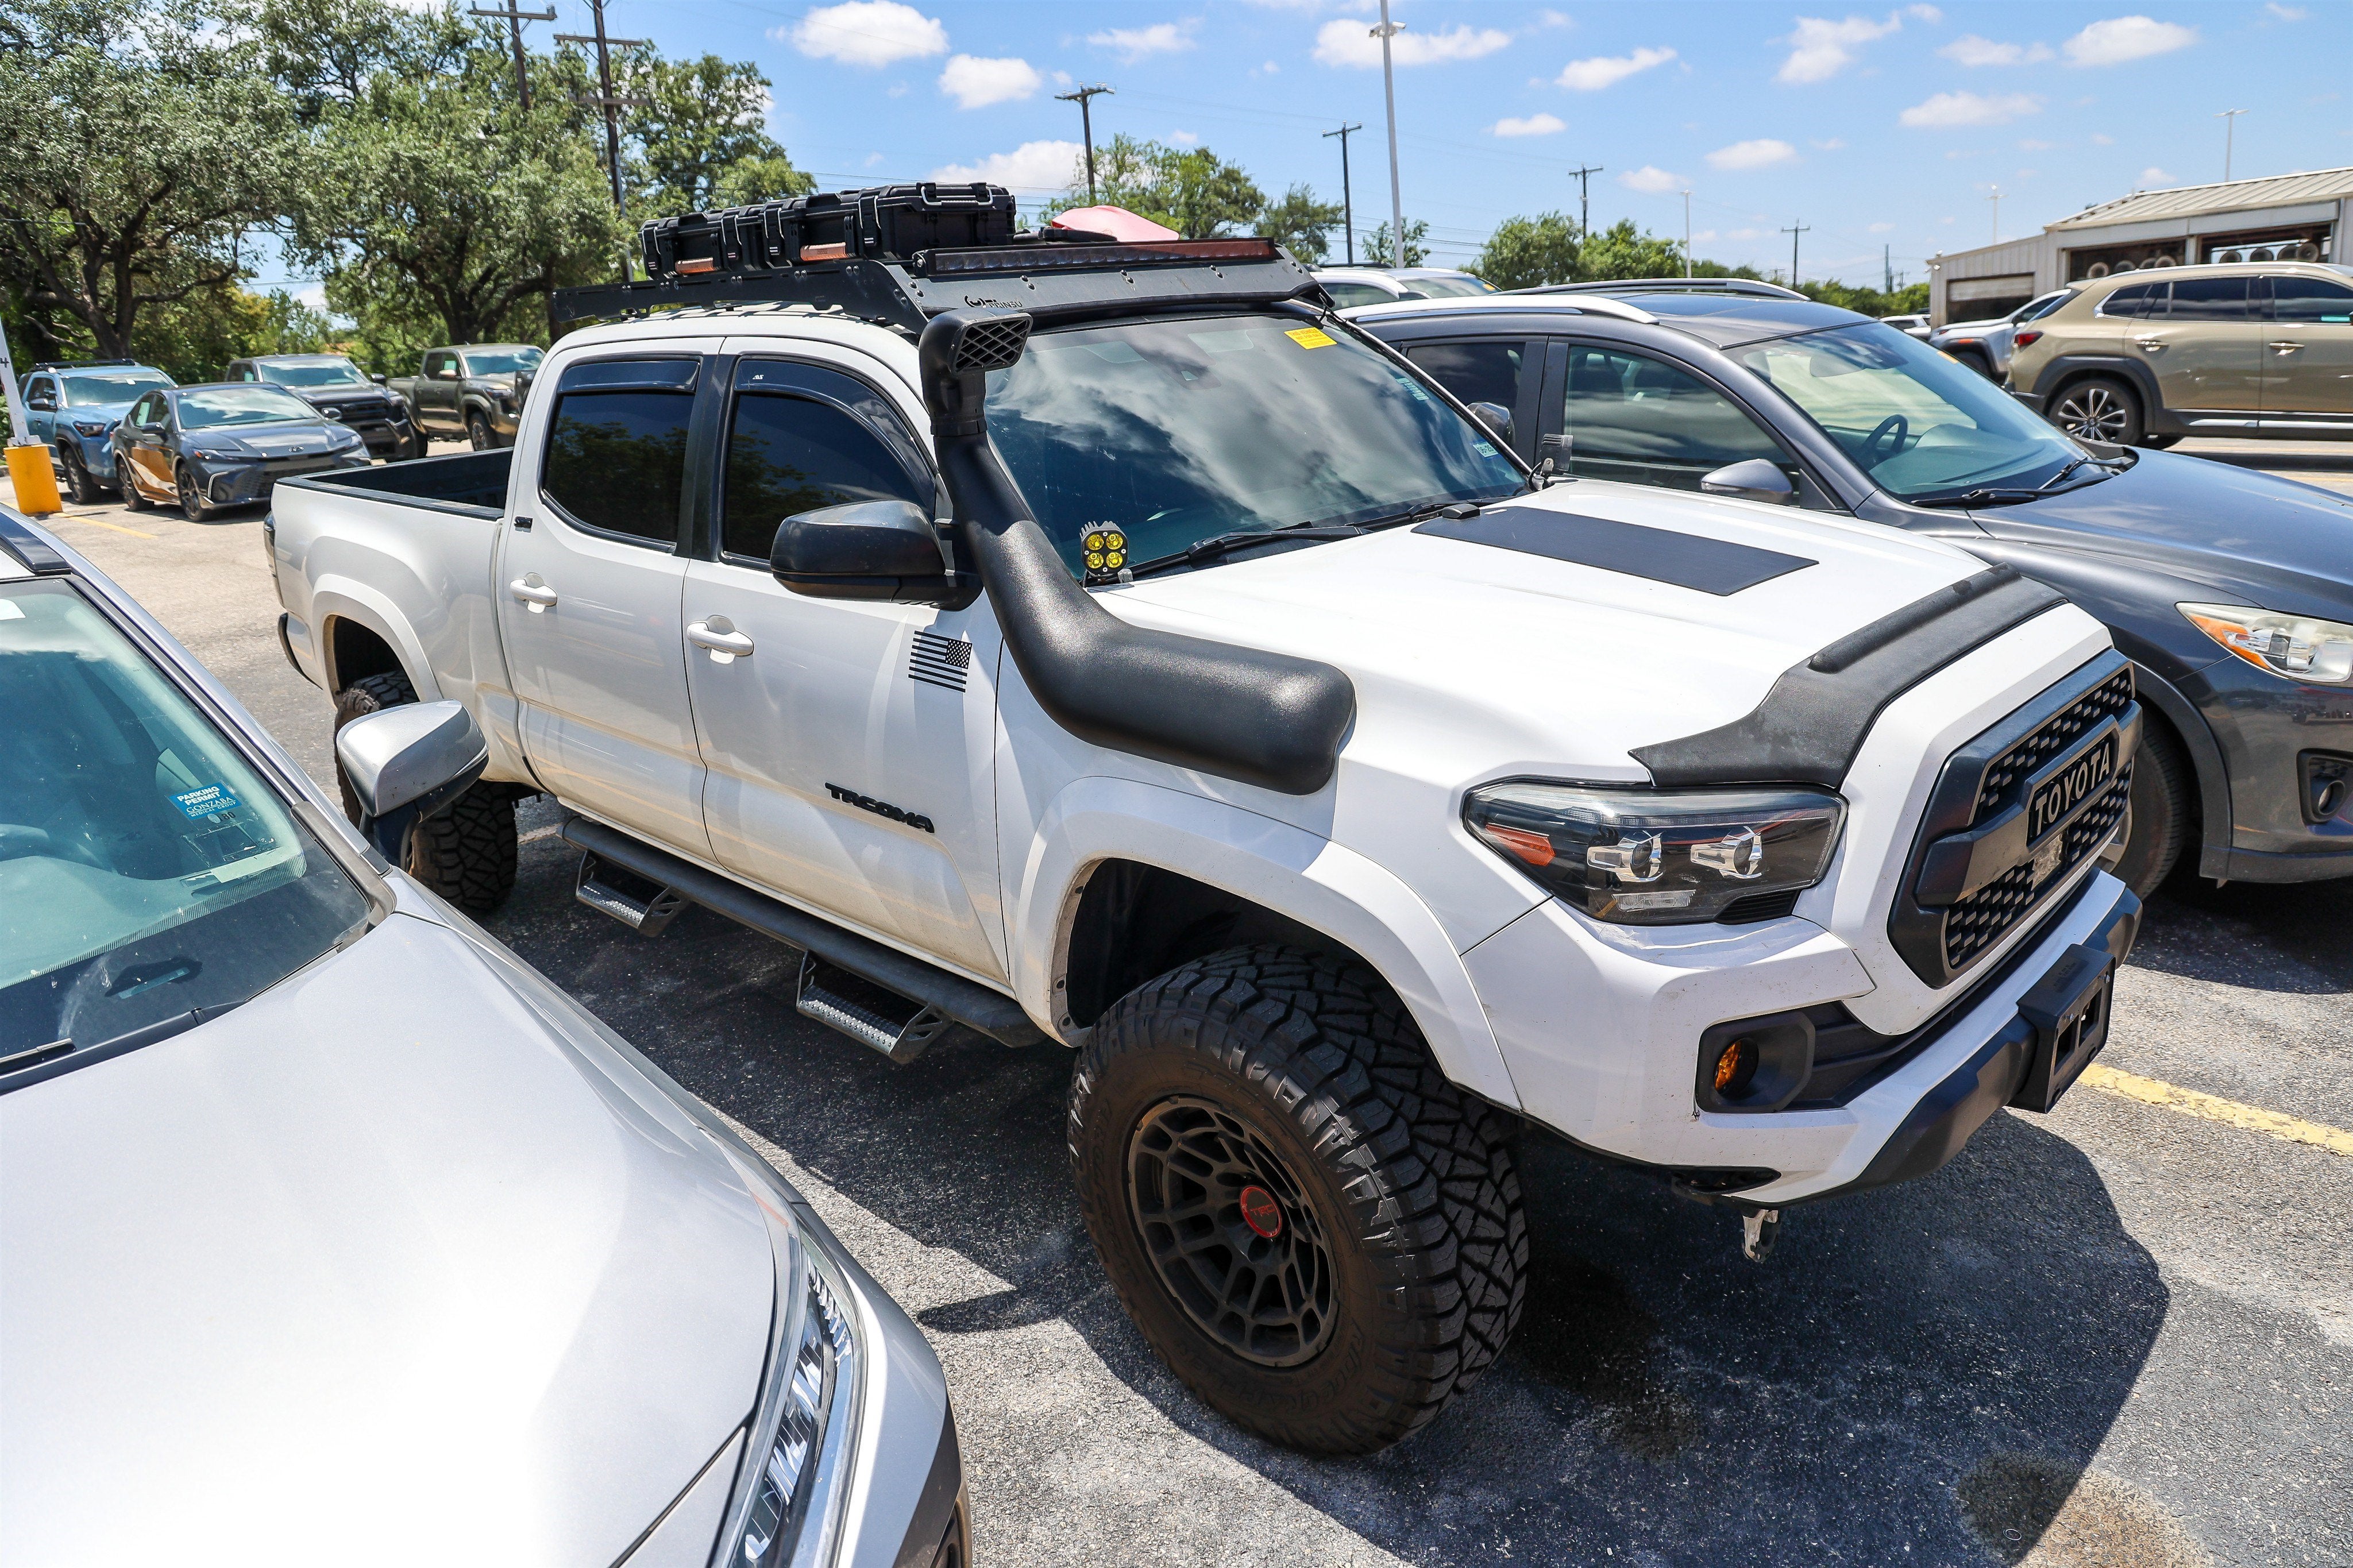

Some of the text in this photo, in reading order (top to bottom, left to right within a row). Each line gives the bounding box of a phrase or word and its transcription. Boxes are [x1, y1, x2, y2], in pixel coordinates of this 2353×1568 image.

[177, 786, 220, 802] PARKING
[2035, 742, 2110, 836] TOYOTA
[184, 791, 221, 806] PERMIT
[186, 797, 234, 813] GONZABA
[191, 801, 237, 817] MEDICAL GROUP
[824, 782, 935, 833] TACOMA
[1249, 1204, 1275, 1216] TRD
